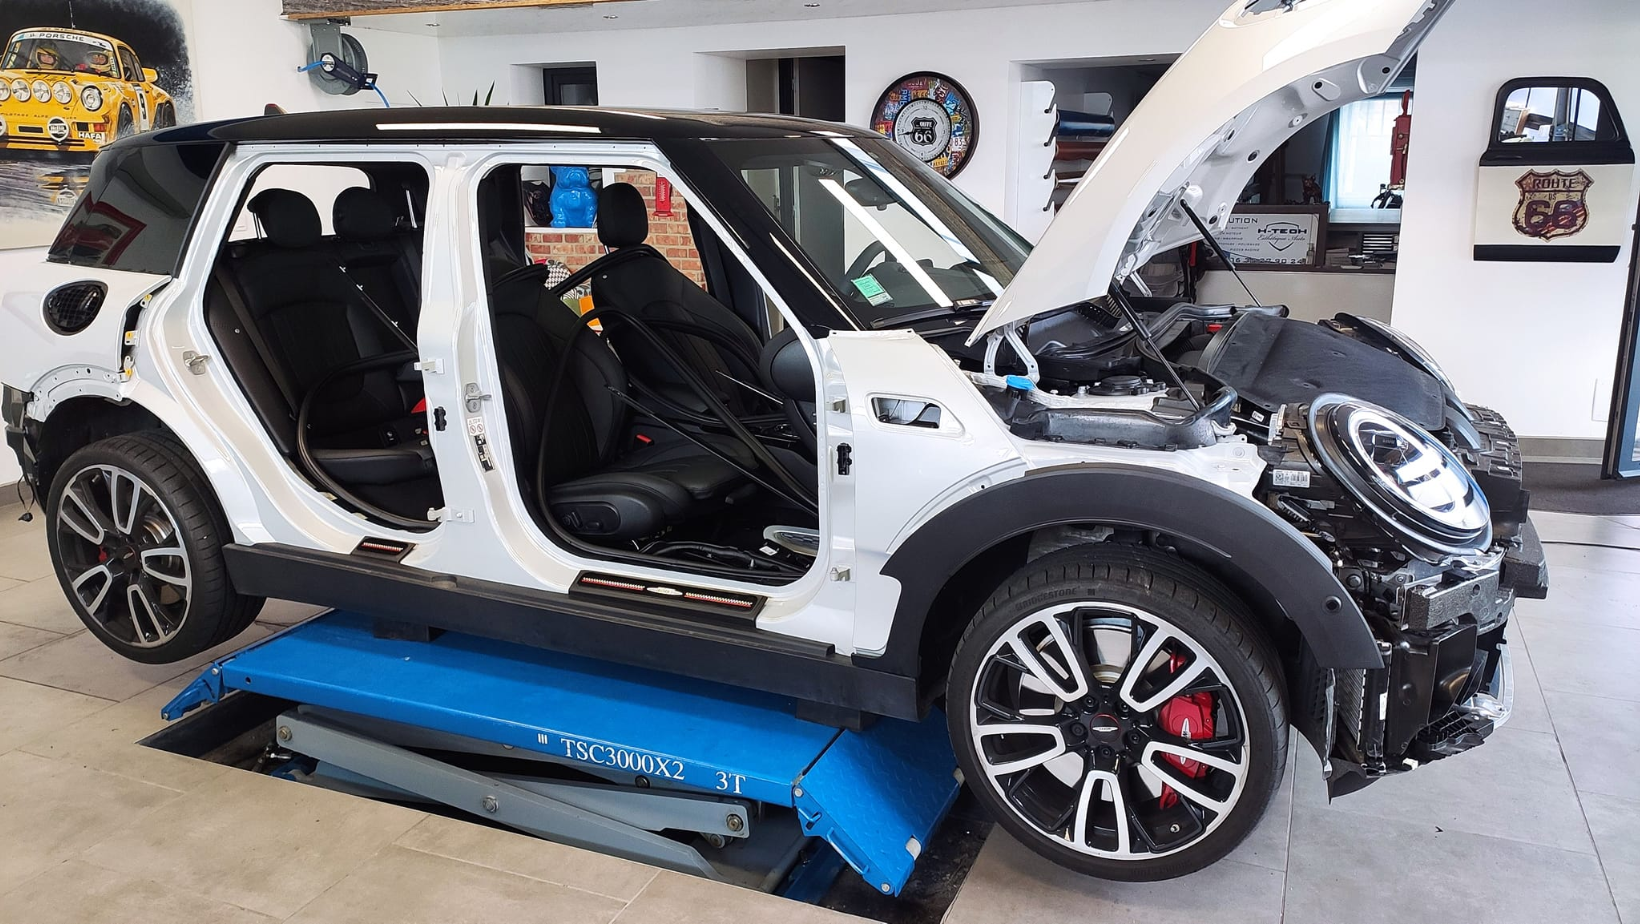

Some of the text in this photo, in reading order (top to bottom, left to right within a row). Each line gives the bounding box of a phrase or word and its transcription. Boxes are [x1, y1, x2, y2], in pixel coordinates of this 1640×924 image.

[39, 32, 84, 42] PORSCHE
[78, 131, 102, 140] HAFA
[914, 131, 933, 143] 66
[1532, 178, 1577, 189] ROUTE
[1525, 200, 1578, 234] 66
[560, 737, 685, 781] TSC3000X2
[715, 770, 746, 795] 3T
